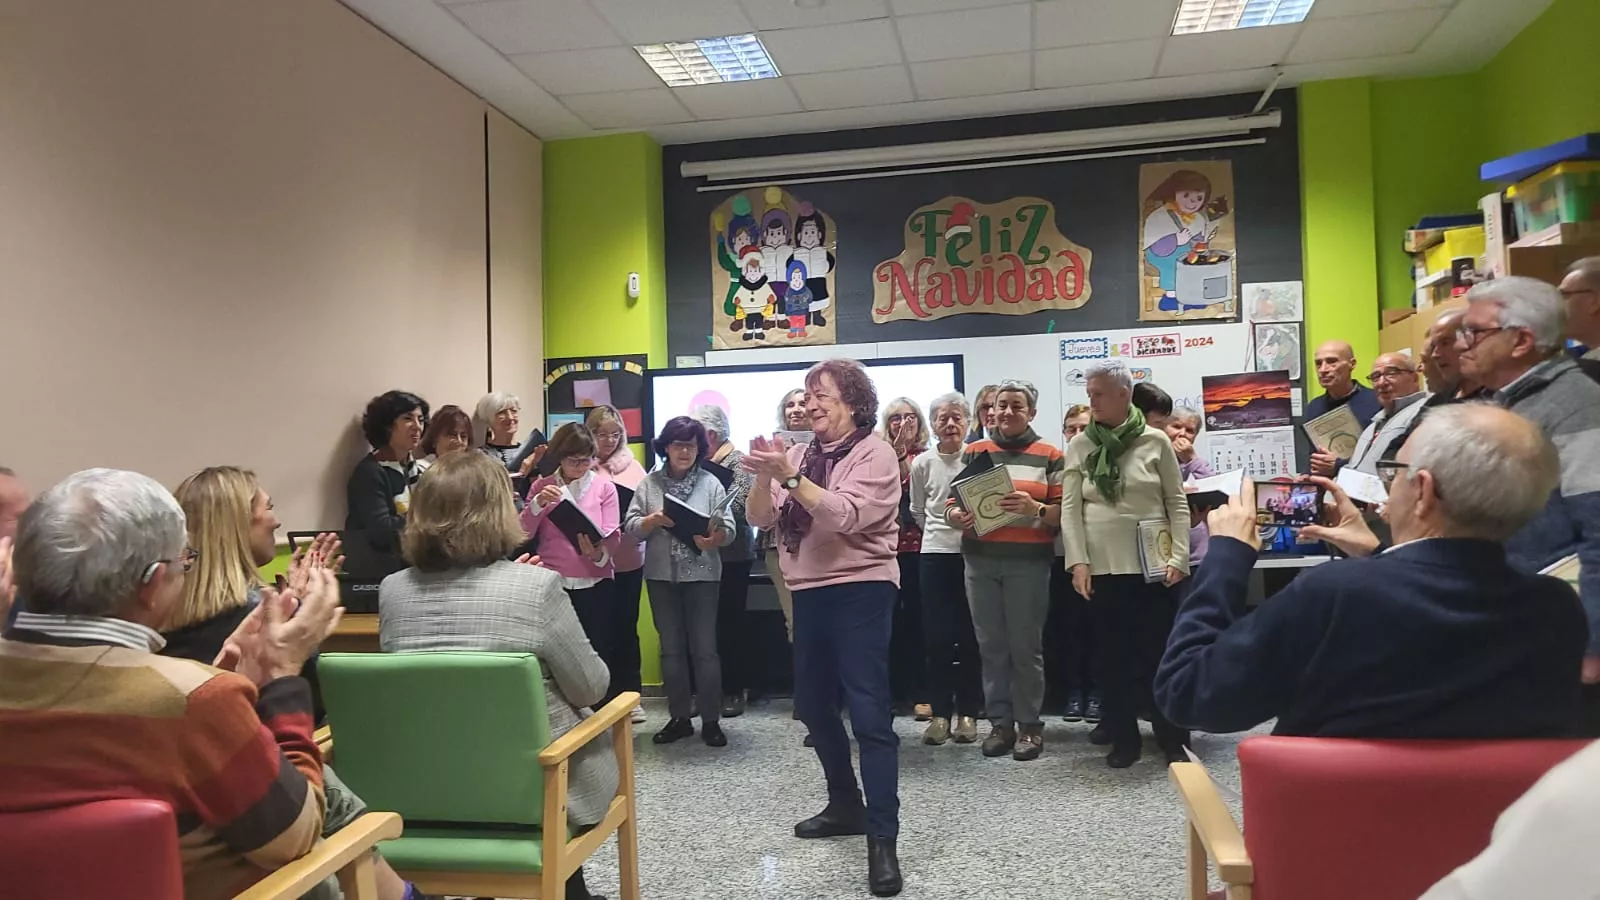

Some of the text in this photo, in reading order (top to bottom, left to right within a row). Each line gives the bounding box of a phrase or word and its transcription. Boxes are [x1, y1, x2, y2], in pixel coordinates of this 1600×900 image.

[876, 249, 1085, 318] Navidad
[1067, 343, 1102, 354] Jueves
[1184, 336, 1214, 348] 2024
